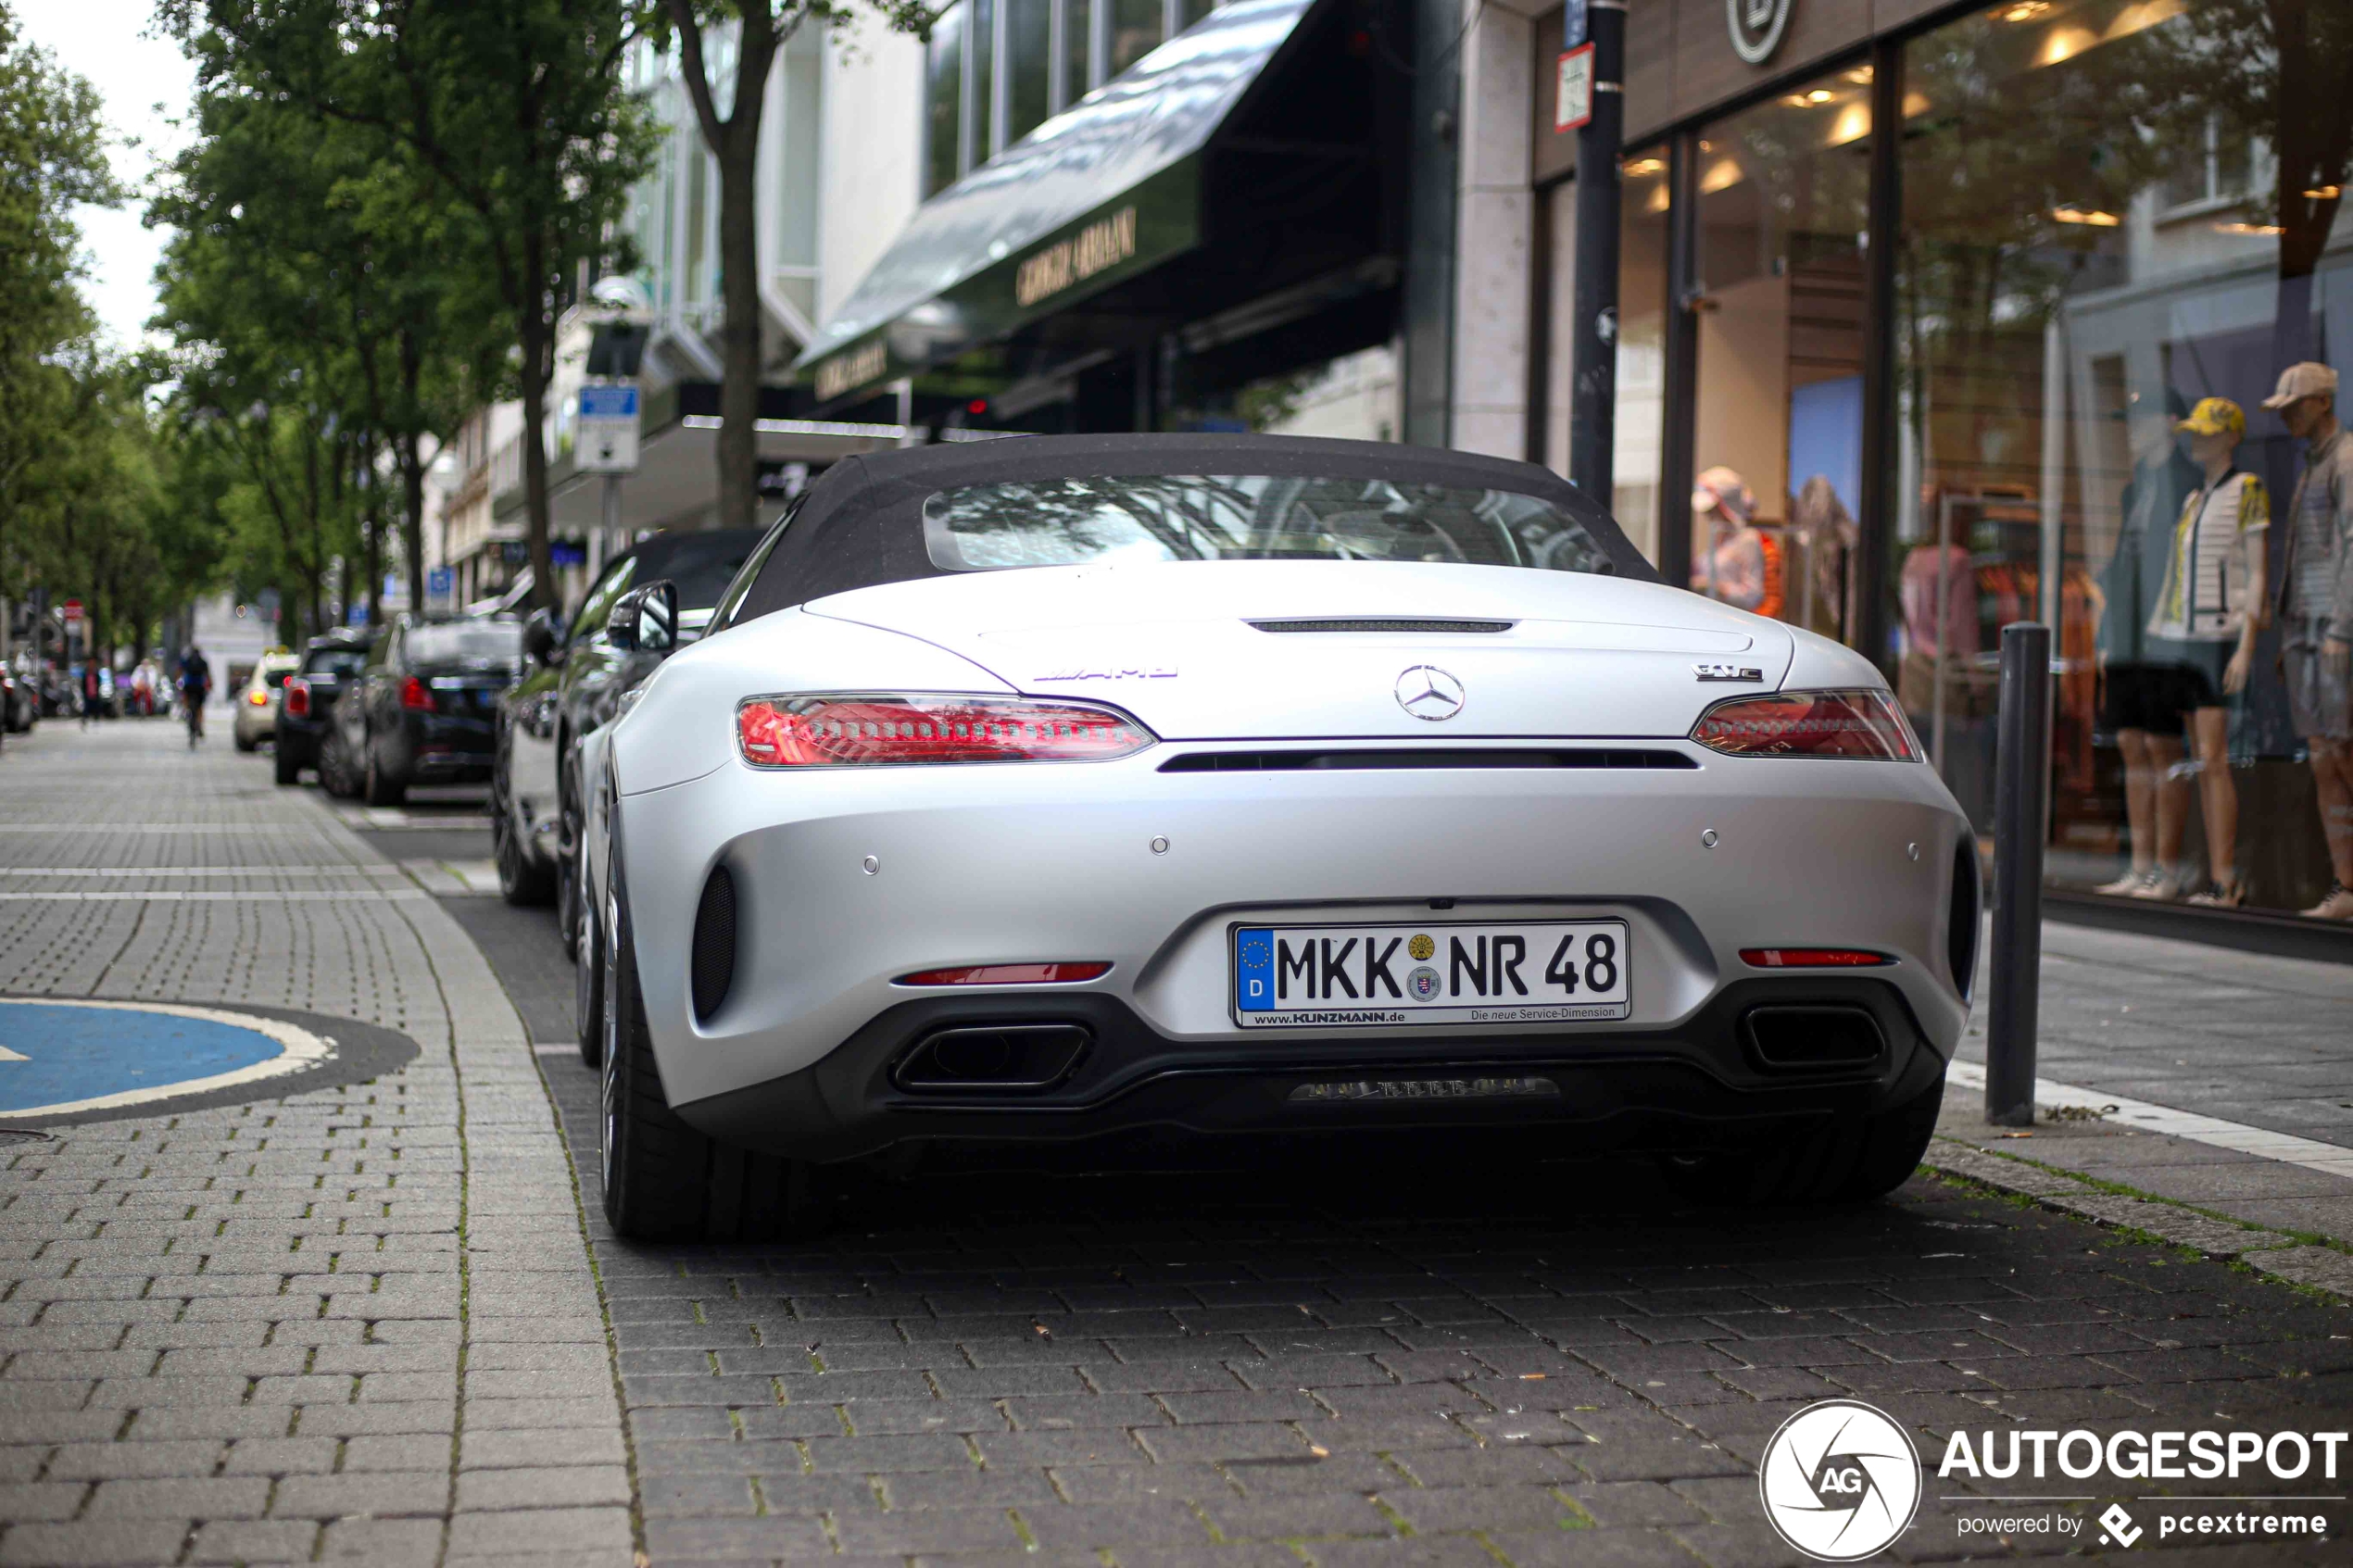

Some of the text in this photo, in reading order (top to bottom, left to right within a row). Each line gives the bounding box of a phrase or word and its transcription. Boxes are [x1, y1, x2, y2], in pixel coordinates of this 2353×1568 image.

[1277, 936, 1403, 999] MKK
[1450, 935, 1529, 997] NR
[1545, 934, 1618, 995] 48
[1250, 979, 1264, 997] D
[1254, 1011, 1405, 1024] www.KUNZMANN.de
[1471, 1007, 1615, 1021] Die neue Service-Dimension
